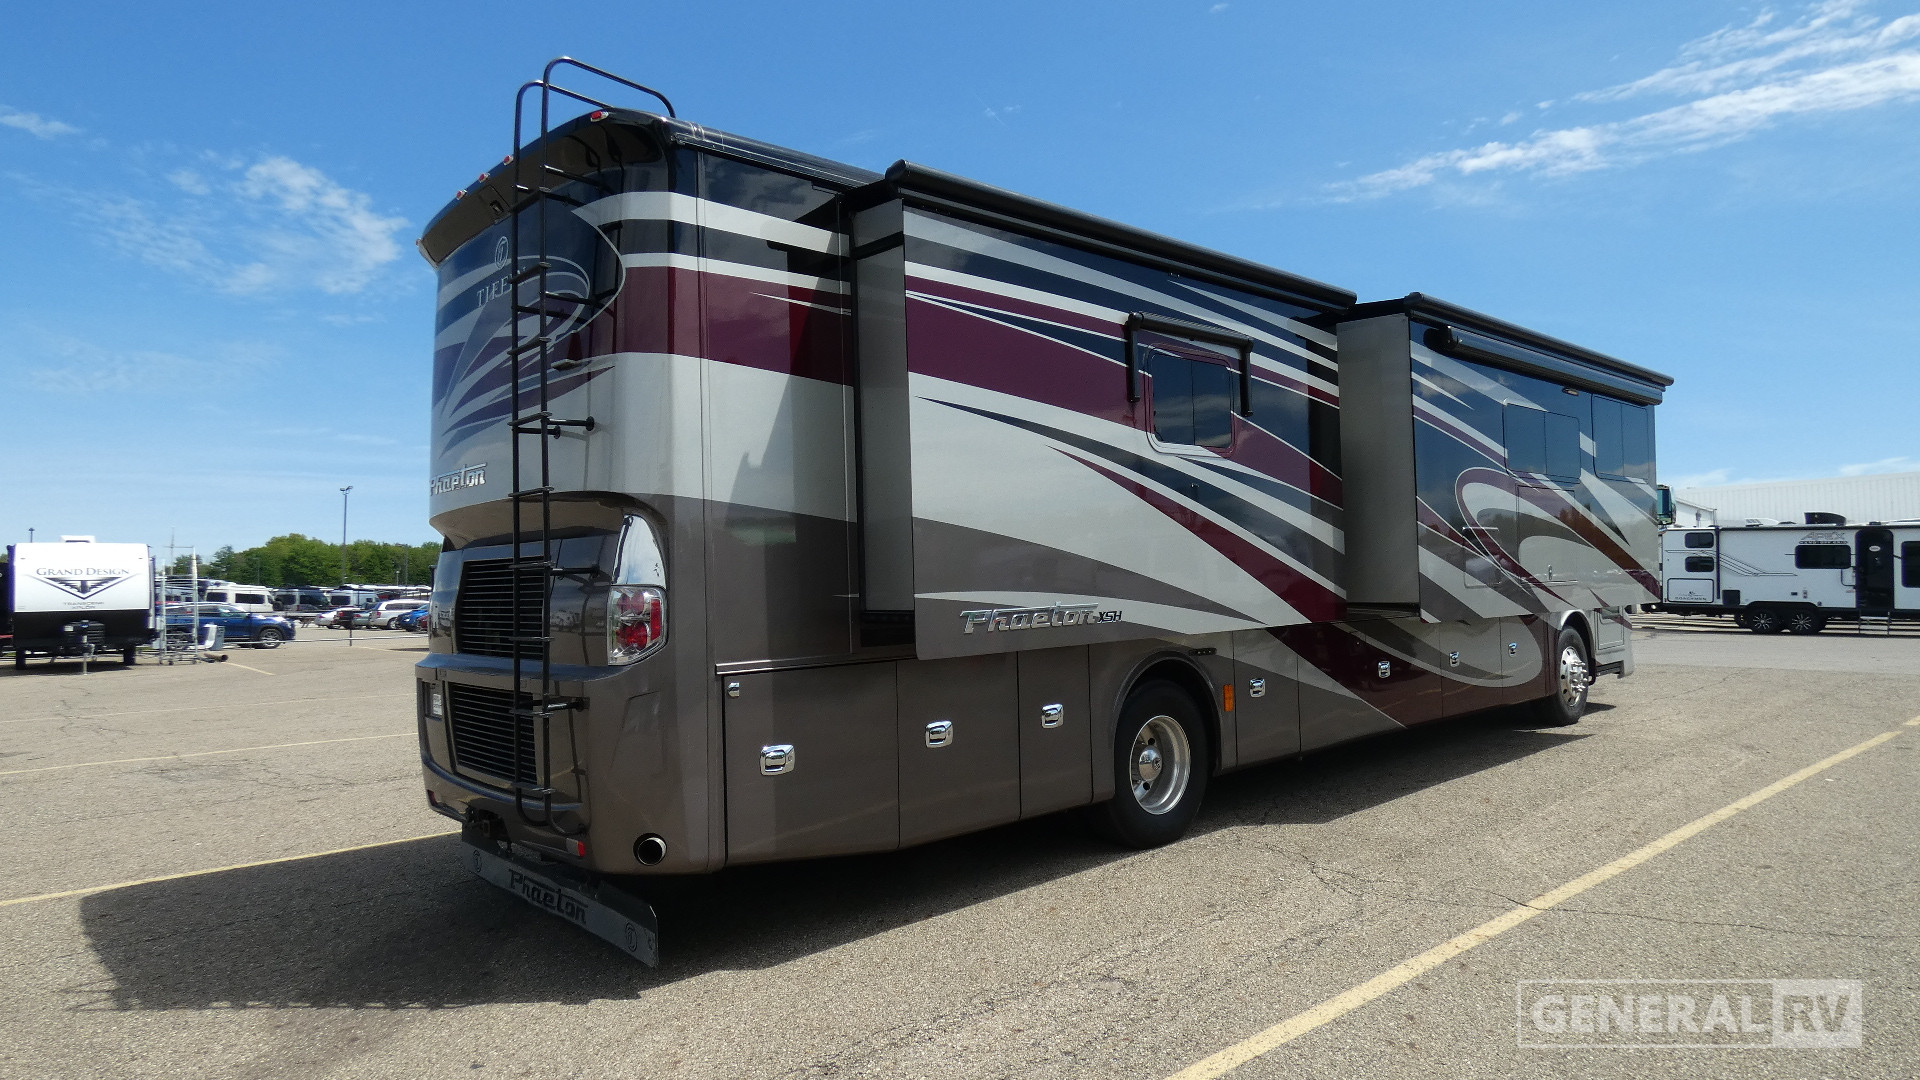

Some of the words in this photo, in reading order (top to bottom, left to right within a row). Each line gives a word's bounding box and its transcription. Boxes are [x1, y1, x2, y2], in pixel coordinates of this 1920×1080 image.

[477, 266, 526, 307] TIFF
[429, 462, 488, 496] Phaeton
[36, 567, 83, 576] GRAND
[86, 567, 130, 575] DESIGN
[960, 601, 1099, 634] Phaeton
[1096, 611, 1123, 624] XSH
[508, 868, 589, 925] Phaeton
